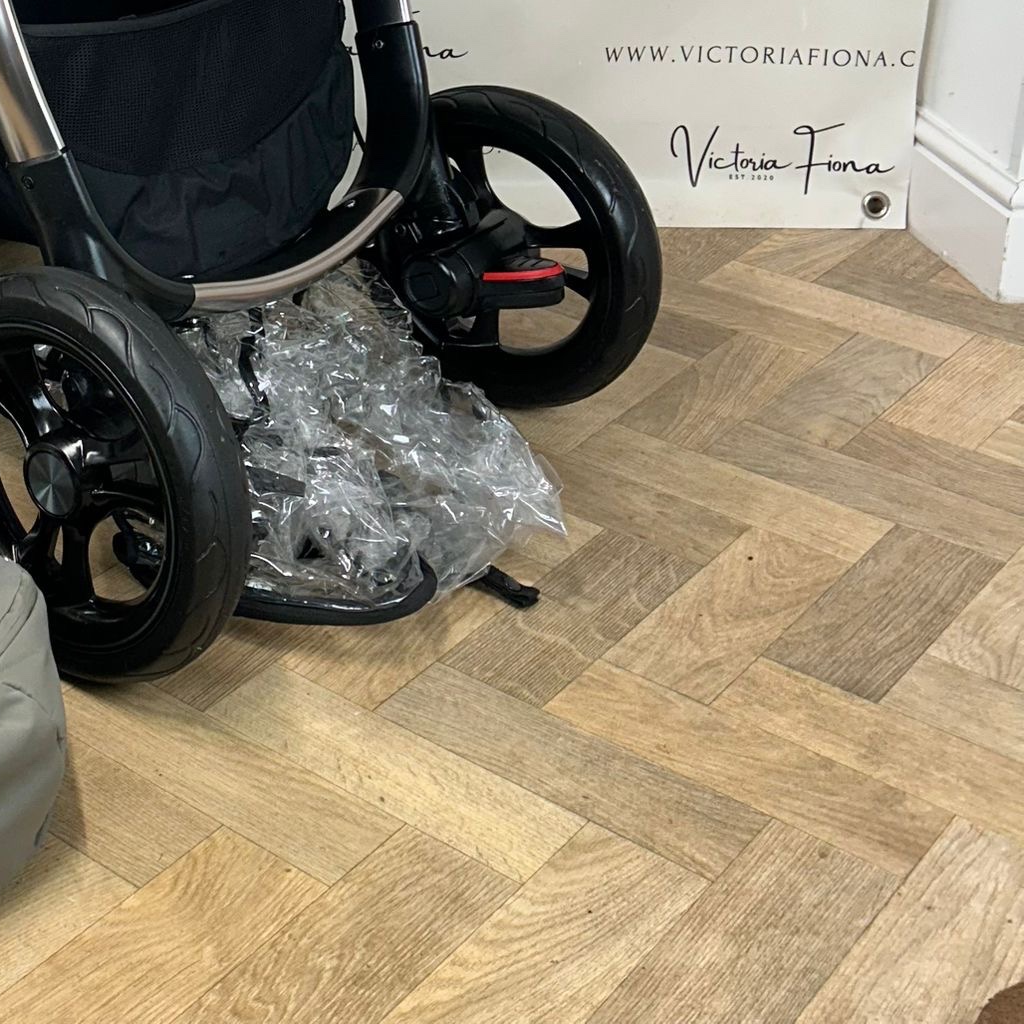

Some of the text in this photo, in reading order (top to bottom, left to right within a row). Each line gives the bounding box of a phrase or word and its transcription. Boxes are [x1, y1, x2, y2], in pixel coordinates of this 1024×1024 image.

[605, 45, 916, 68] WWW.VICTORIAFIONA.C
[670, 123, 895, 195] Victoria Fiona
